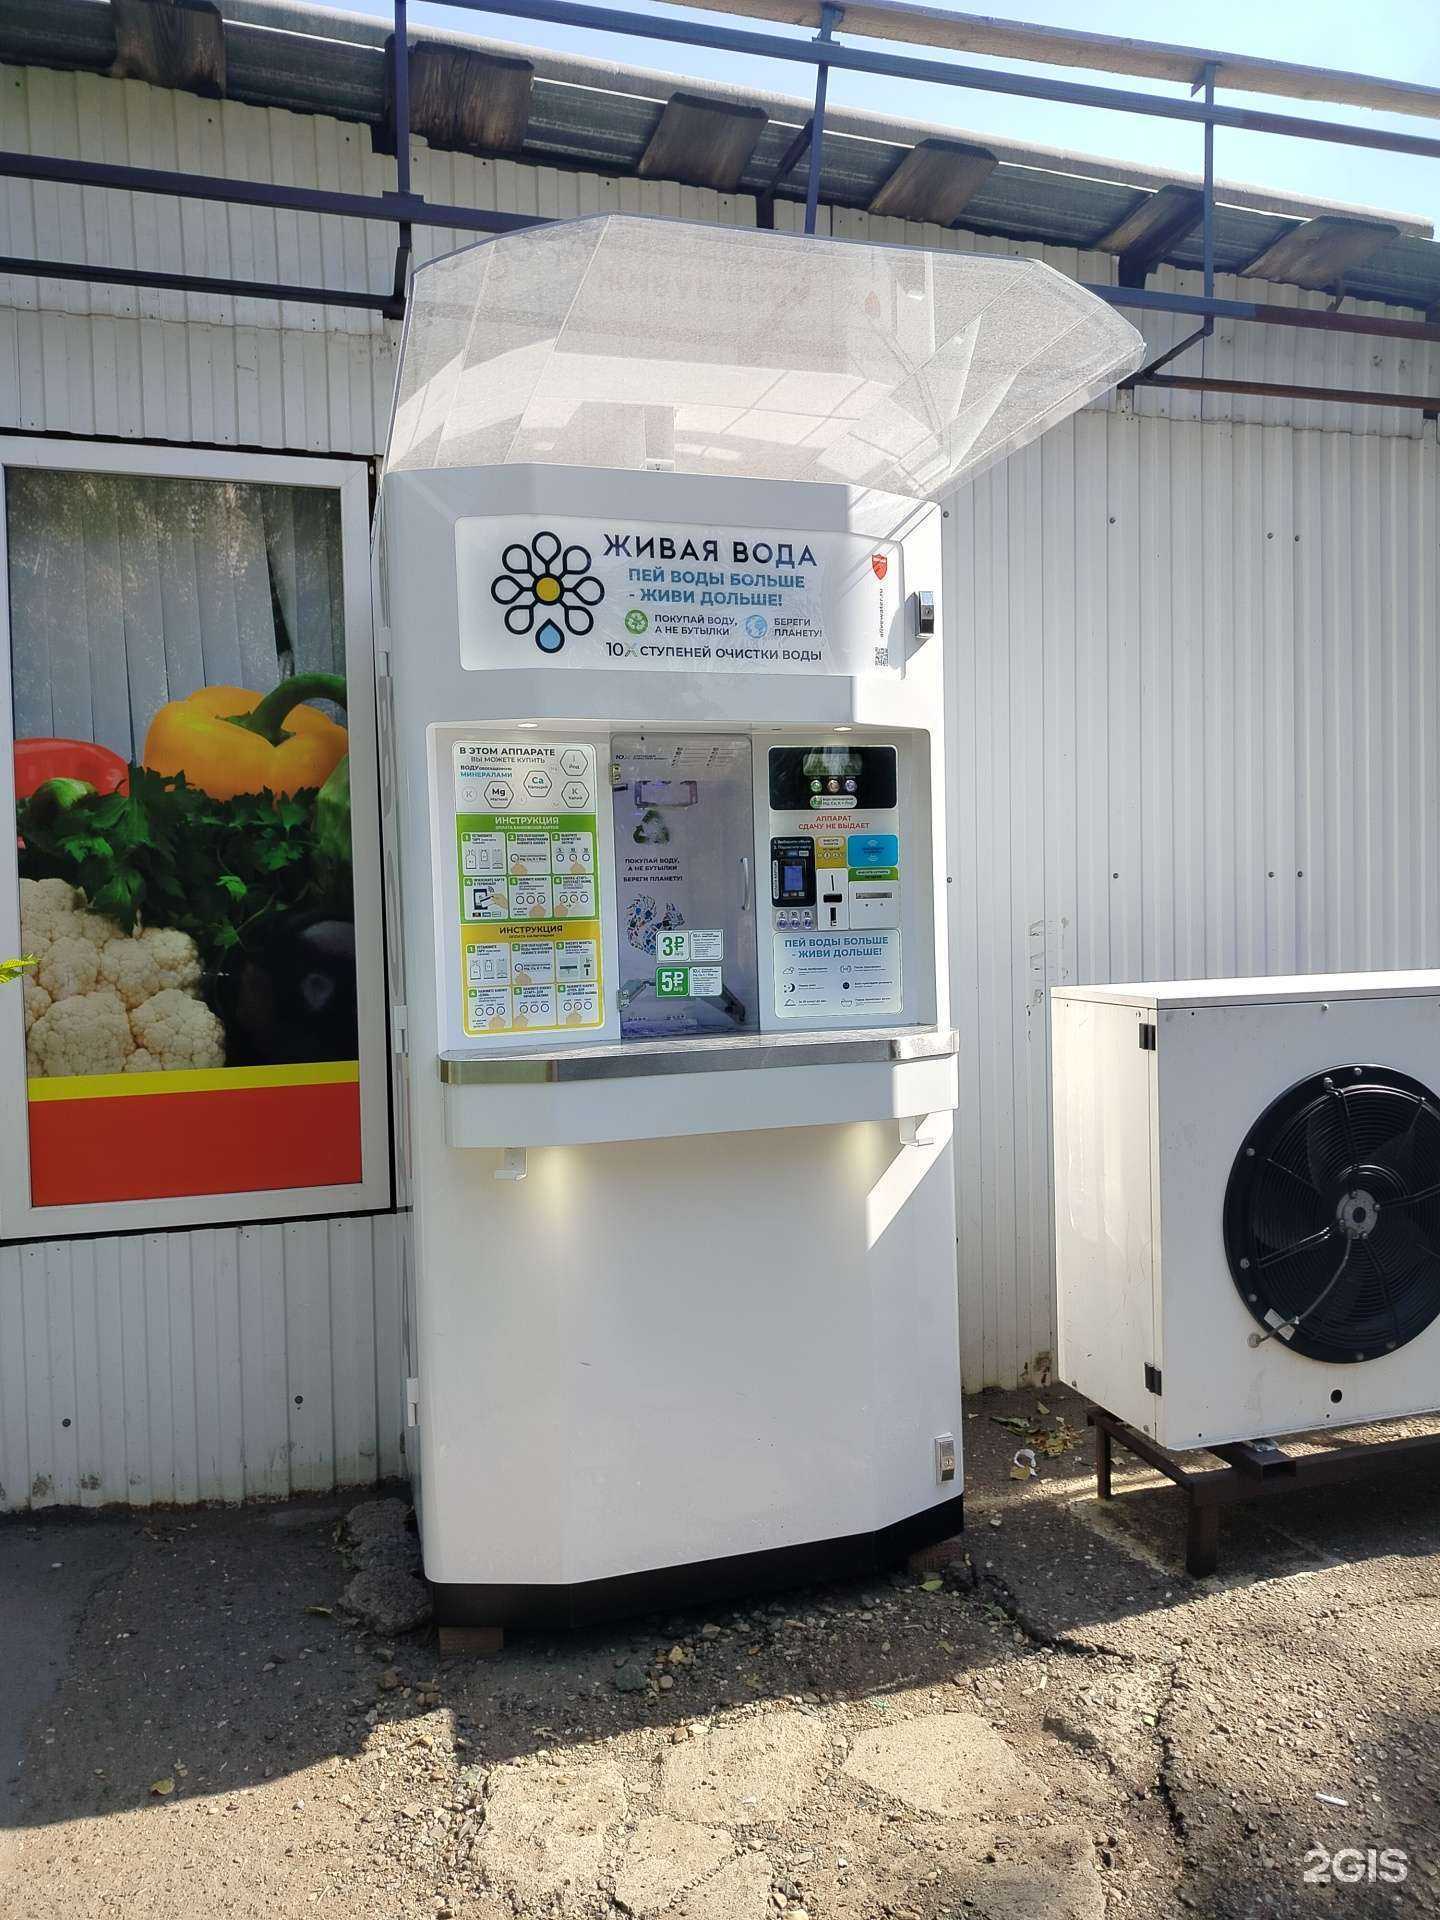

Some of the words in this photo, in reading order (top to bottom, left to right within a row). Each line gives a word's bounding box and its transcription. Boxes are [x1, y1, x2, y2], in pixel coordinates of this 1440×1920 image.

[603, 534, 719, 562] ЖИВАЯ
[733, 541, 817, 569] ВОДА
[628, 566, 665, 583] ПЕЙ
[671, 571, 724, 587] ВОДЫ
[730, 573, 805, 588] БОЛЬШЕ
[640, 588, 695, 604] ЖИВИ
[700, 592, 783, 607] ДОЛЬШЕ!
[654, 613, 704, 625] ПОКУПАЙ
[707, 616, 738, 627] ВОДУ,
[774, 617, 811, 627] БЕРЕГИ
[655, 626, 663, 634] А
[665, 626, 678, 635] НЕ
[681, 626, 730, 636] БУТЫЛКИ
[774, 629, 823, 638] ПЛАНЕТУ!
[640, 645, 711, 658] СТУПЕНЕЙ
[716, 647, 778, 660] ОЧИСТКИ
[783, 650, 822, 662] ВОДЫ
[459, 747, 466, 755] В
[468, 747, 498, 755] ЭТОМ
[501, 748, 556, 756] АППАРАТЕ
[531, 777, 544, 785] Ca
[491, 788, 506, 797] Mg
[495, 816, 559, 826] ИНСТРУКЦИЯ
[499, 925, 563, 935] ИНСТРУКЦИЯ
[784, 938, 807, 948] ПЕЙ
[809, 938, 840, 948] ВОДЫ
[844, 936, 889, 946] БОЛЬШЕ
[798, 950, 830, 958] ЖИВИ
[833, 947, 882, 958] ДОЛЬШЕ!
